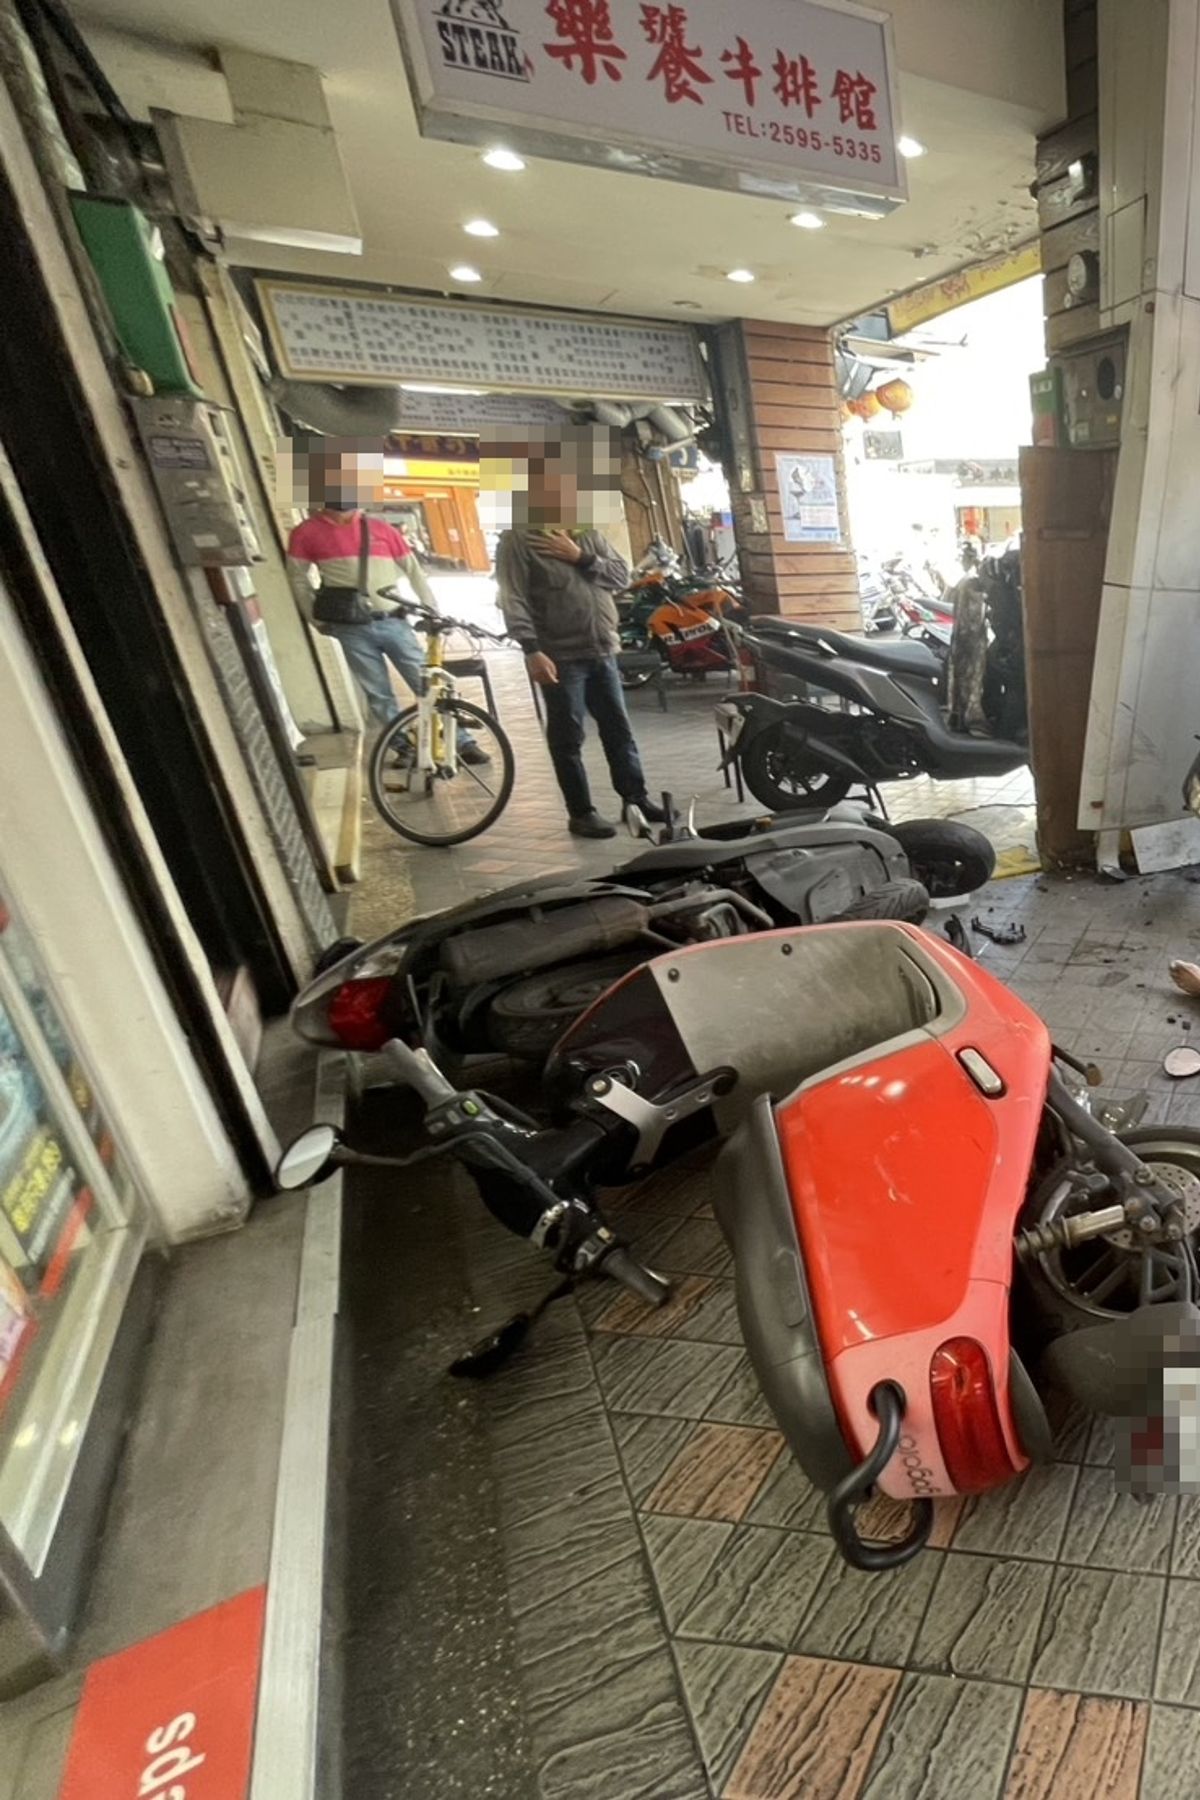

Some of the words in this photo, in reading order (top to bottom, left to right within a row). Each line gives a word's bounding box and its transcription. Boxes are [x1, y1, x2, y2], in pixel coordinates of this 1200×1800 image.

[436, 20, 523, 76] STEAK
[722, 111, 881, 163] TEL:2595-5335
[898, 1435, 942, 1494] gogoro
